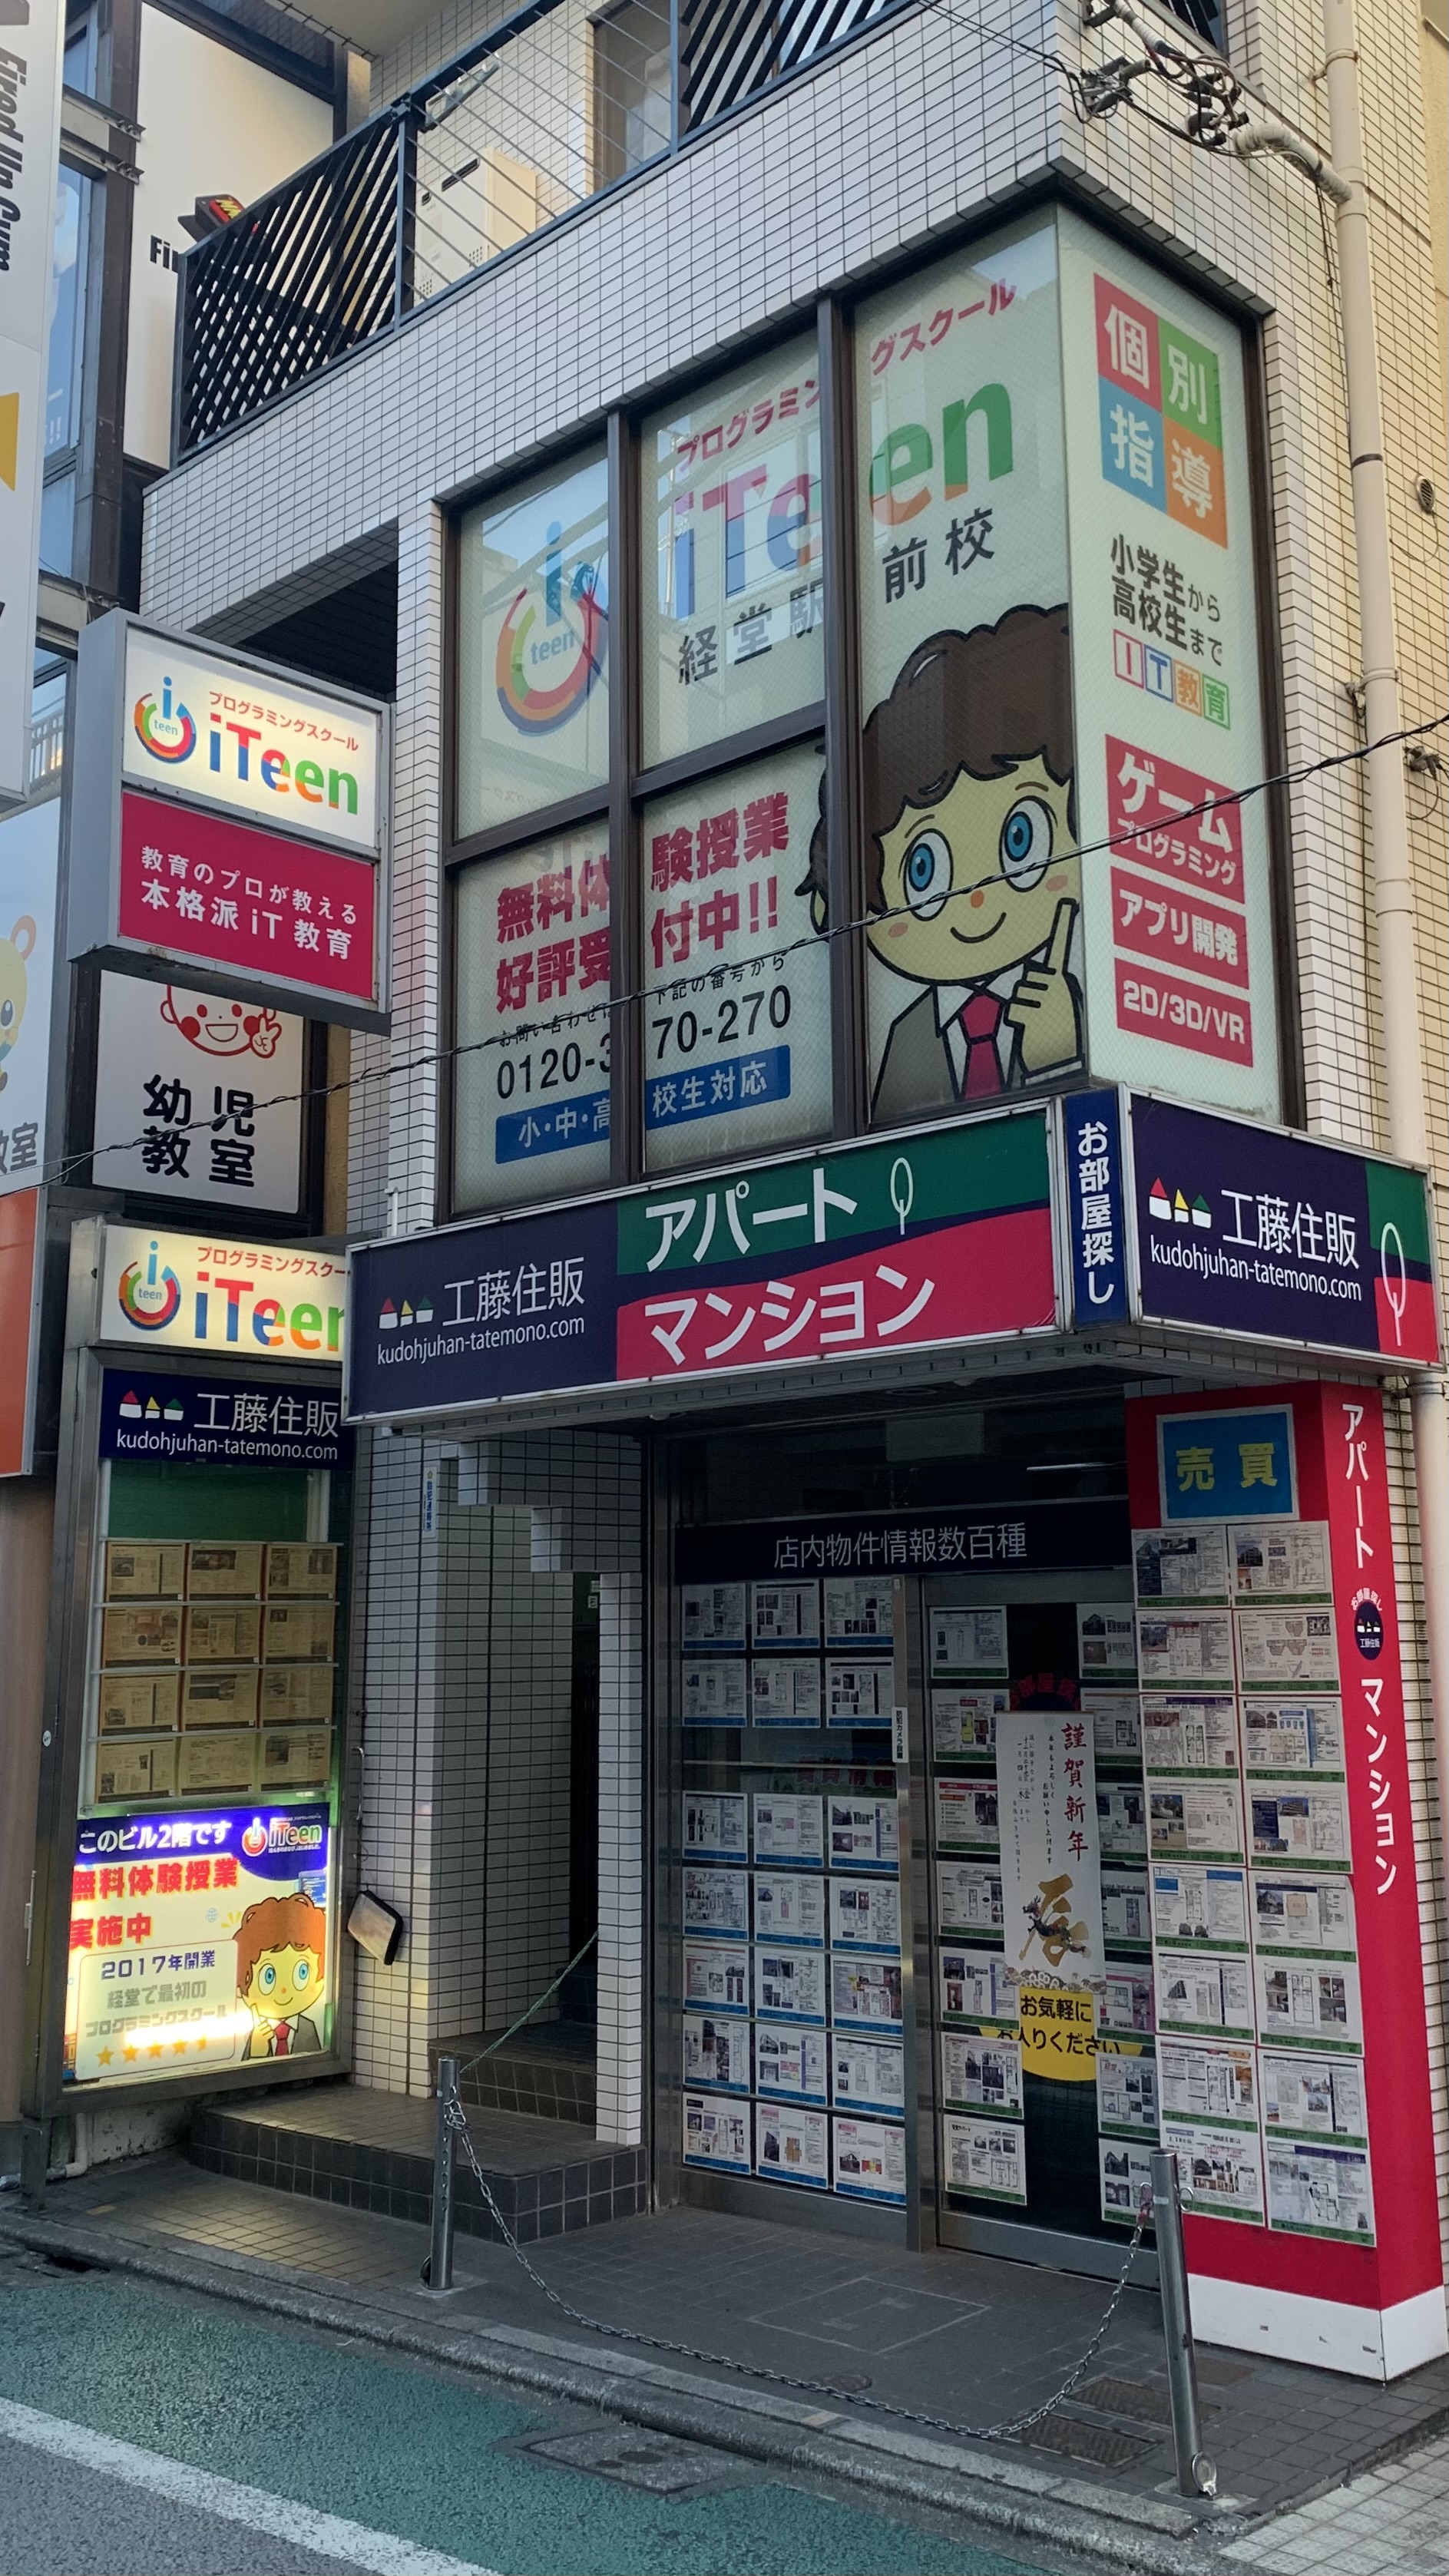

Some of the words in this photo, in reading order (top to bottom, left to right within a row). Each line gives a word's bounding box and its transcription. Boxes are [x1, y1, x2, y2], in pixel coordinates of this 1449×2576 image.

[1103, 303, 1209, 426] 個別
[1110, 403, 1214, 520] 指導
[1110, 534, 1221, 623] 小学生から
[1111, 574, 1222, 667] 高校生まで
[154, 720, 178, 736] teen
[209, 690, 359, 752] プログラミングスクール
[209, 713, 359, 815] iTeen
[1117, 752, 1233, 853] ゲーム
[1117, 817, 1237, 886] プログラミング
[141, 845, 357, 925] 教育のプロが教える
[1119, 888, 1239, 967] アプリ開発
[1123, 980, 1246, 1044] 2D/3D/VR
[142, 1074, 255, 1137] 幼児
[141, 1126, 255, 1188] 教室
[645, 1167, 858, 1272] アパート
[1077, 1121, 1115, 1305] お部屋探し
[1221, 1189, 1359, 1270] 工藤住販
[197, 1246, 345, 1278] プログラミングスクー
[442, 1256, 585, 1327] 工藤住販
[1150, 1235, 1362, 1301] kudohjuhan-tatemono.com
[138, 1287, 162, 1301] teen
[377, 1316, 585, 1365] kudohjuhan-tatemono.com
[116, 1429, 338, 1461] kudohjuhan-tatemono.com
[194, 1393, 339, 1438] 工藤住販
[1176, 1441, 1278, 1492] 売買
[1341, 1403, 1374, 1569] アパート
[774, 1522, 1028, 1569] 店内物件情報数百種
[1061, 1722, 1089, 1862] 謹賀新年
[78, 1820, 232, 1854] このビル2階です
[270, 1822, 322, 1847] iTeen
[72, 1857, 239, 1903] 無料体験授業
[70, 1913, 152, 1951] 実施中
[101, 1949, 216, 1980] 2017年開業
[107, 1980, 207, 2009] 経堂で最初の
[85, 2004, 228, 2038] プログラミングスクール
[1021, 1995, 1092, 2022] お気軽に
